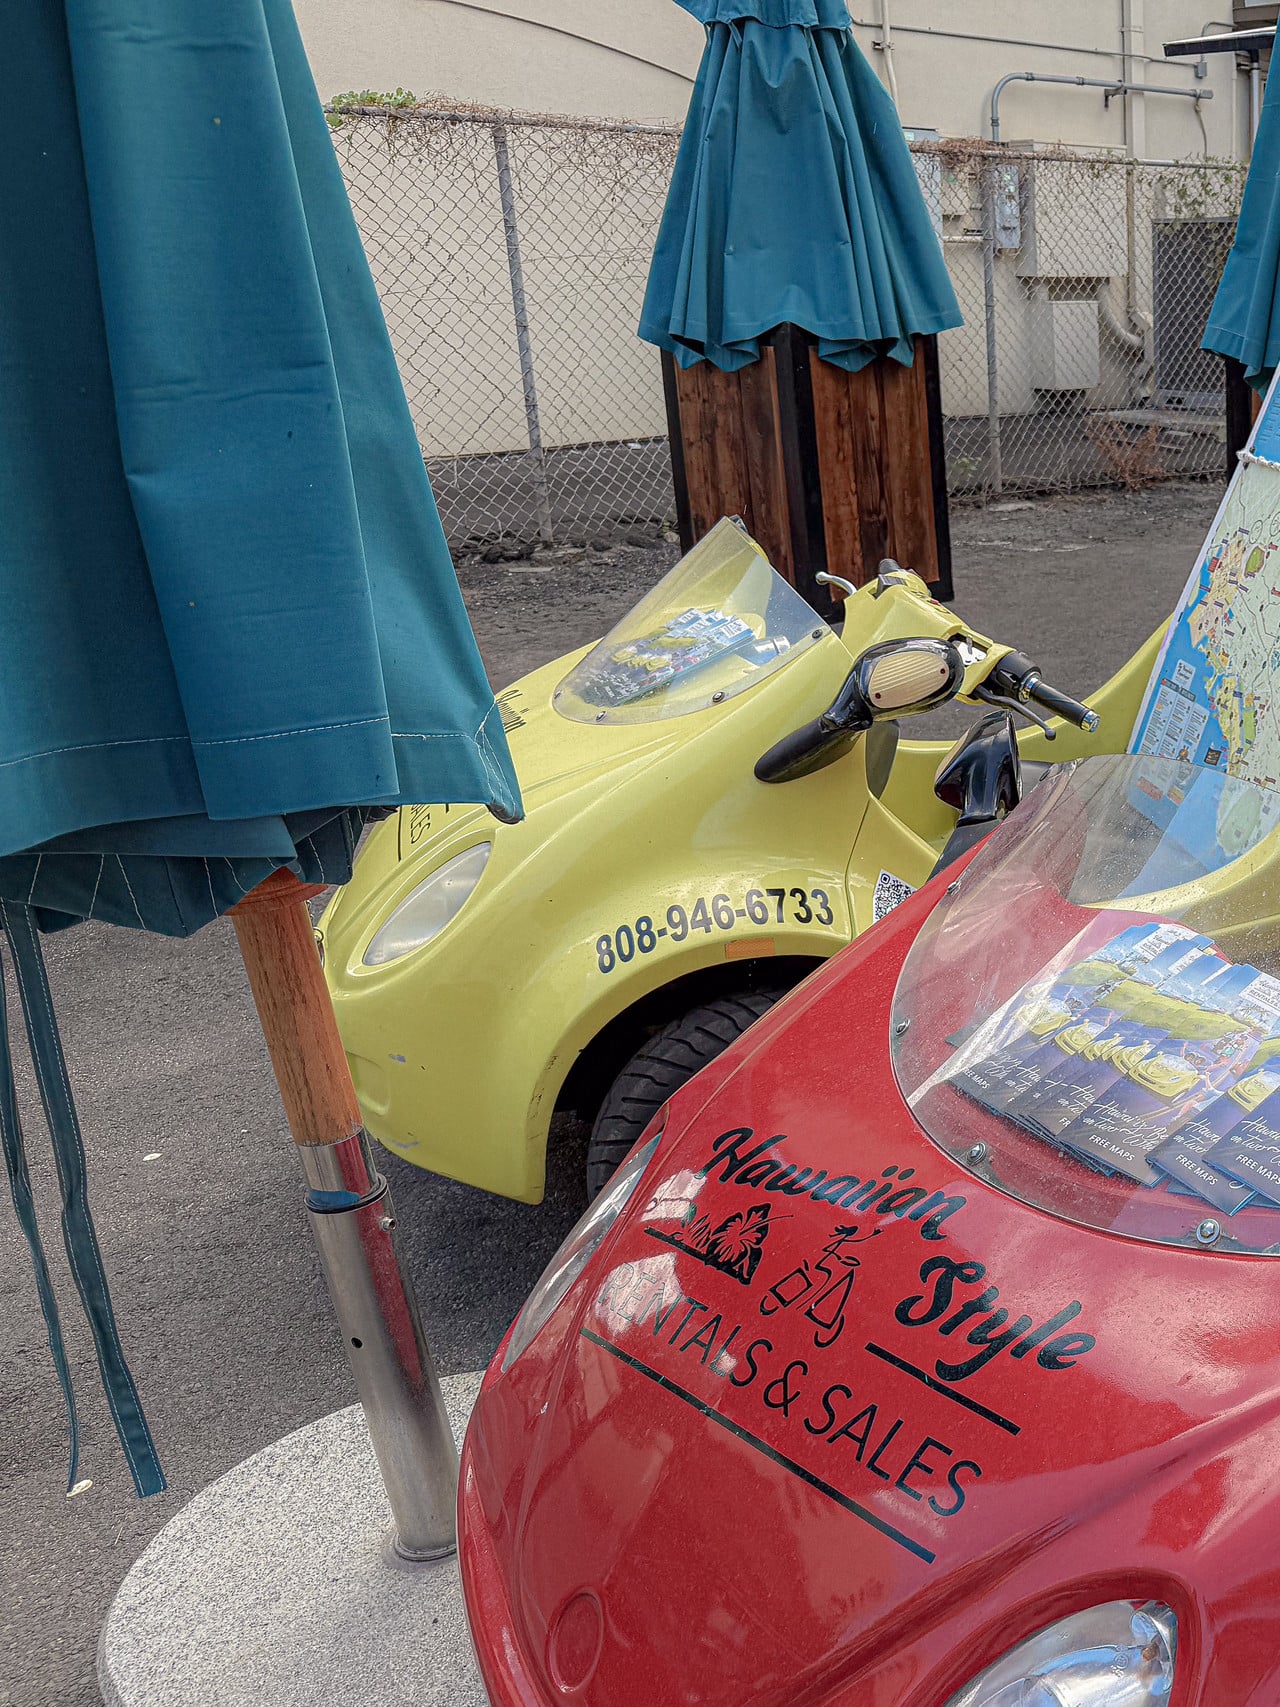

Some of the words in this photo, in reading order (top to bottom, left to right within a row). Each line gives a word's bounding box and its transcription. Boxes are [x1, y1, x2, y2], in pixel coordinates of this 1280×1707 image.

[596, 887, 834, 974] 808-946-6733
[695, 1127, 967, 1241] Hawaiian
[1089, 1134, 1109, 1148] FREE
[1109, 1144, 1135, 1161] MAPS
[1236, 1154, 1258, 1170] FREE
[894, 1255, 1097, 1382] Style
[597, 1262, 773, 1387] RENTALS
[763, 1360, 809, 1417] &
[803, 1383, 983, 1516] SALES
